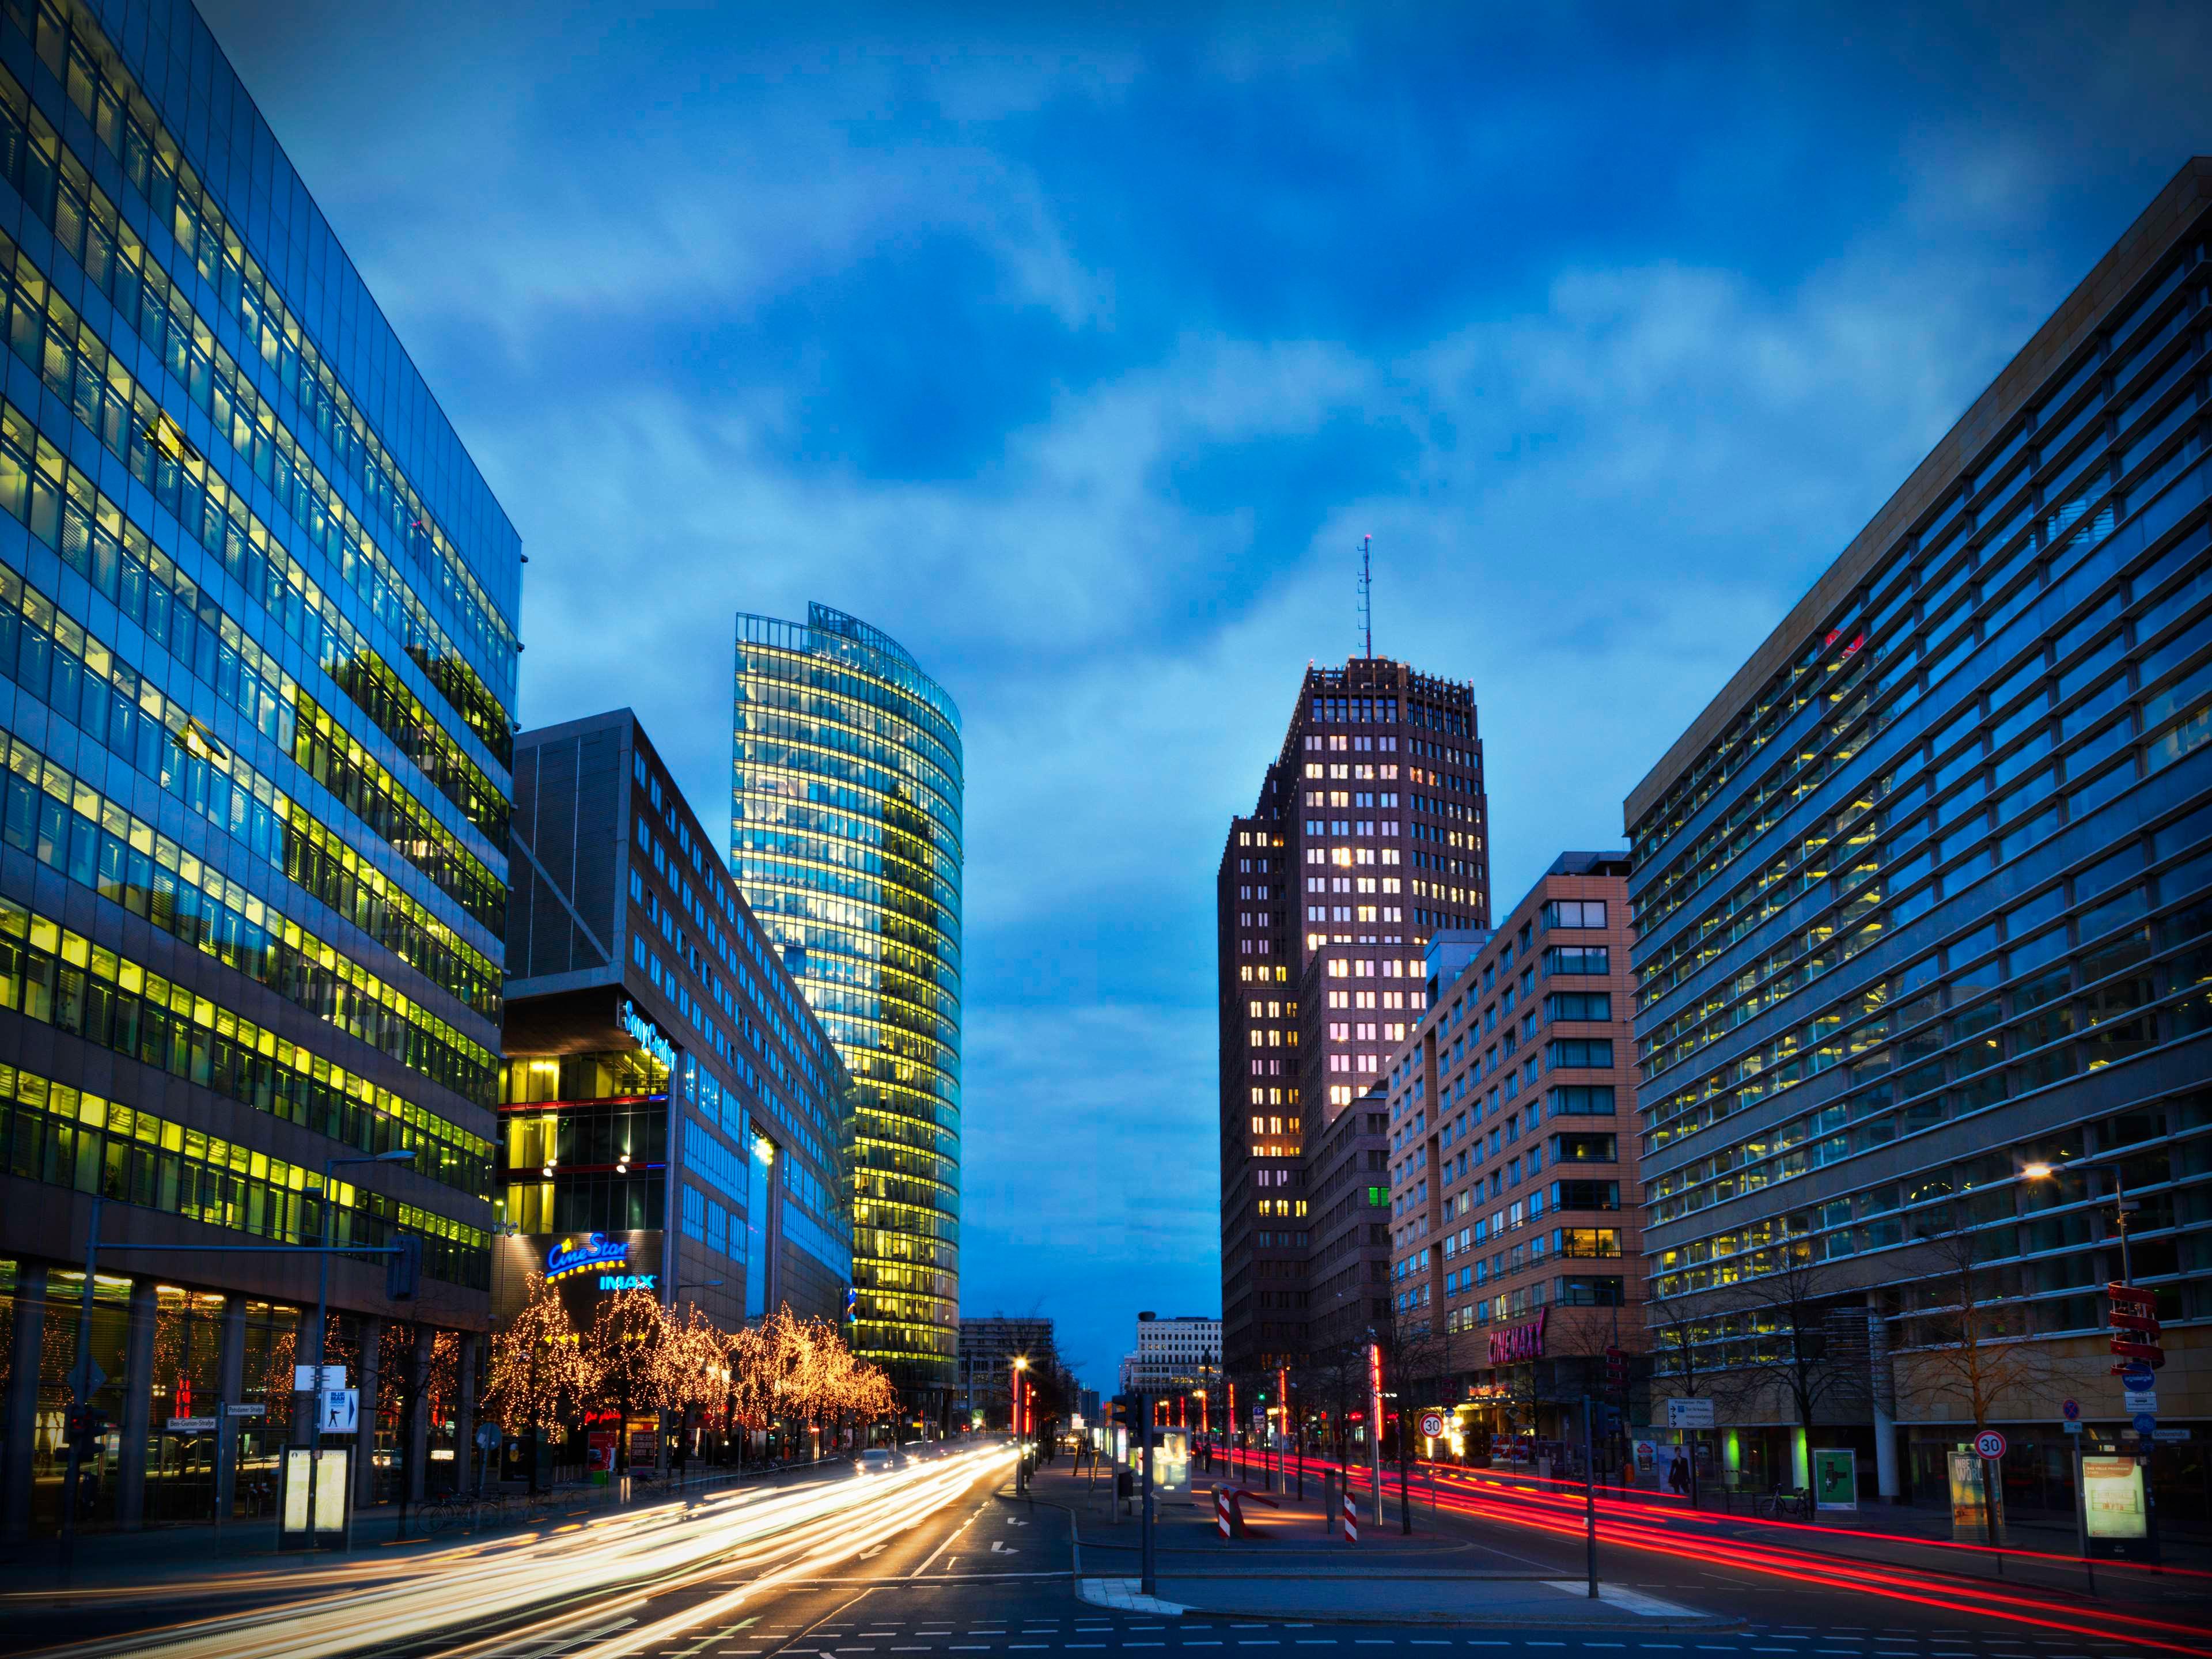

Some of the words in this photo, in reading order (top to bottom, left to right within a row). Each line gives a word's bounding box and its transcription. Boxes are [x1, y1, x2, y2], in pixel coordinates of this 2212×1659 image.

[600, 1275, 654, 1290] IMAX
[1425, 1420, 1440, 1431] 30
[1981, 1439, 1999, 1452] 30
